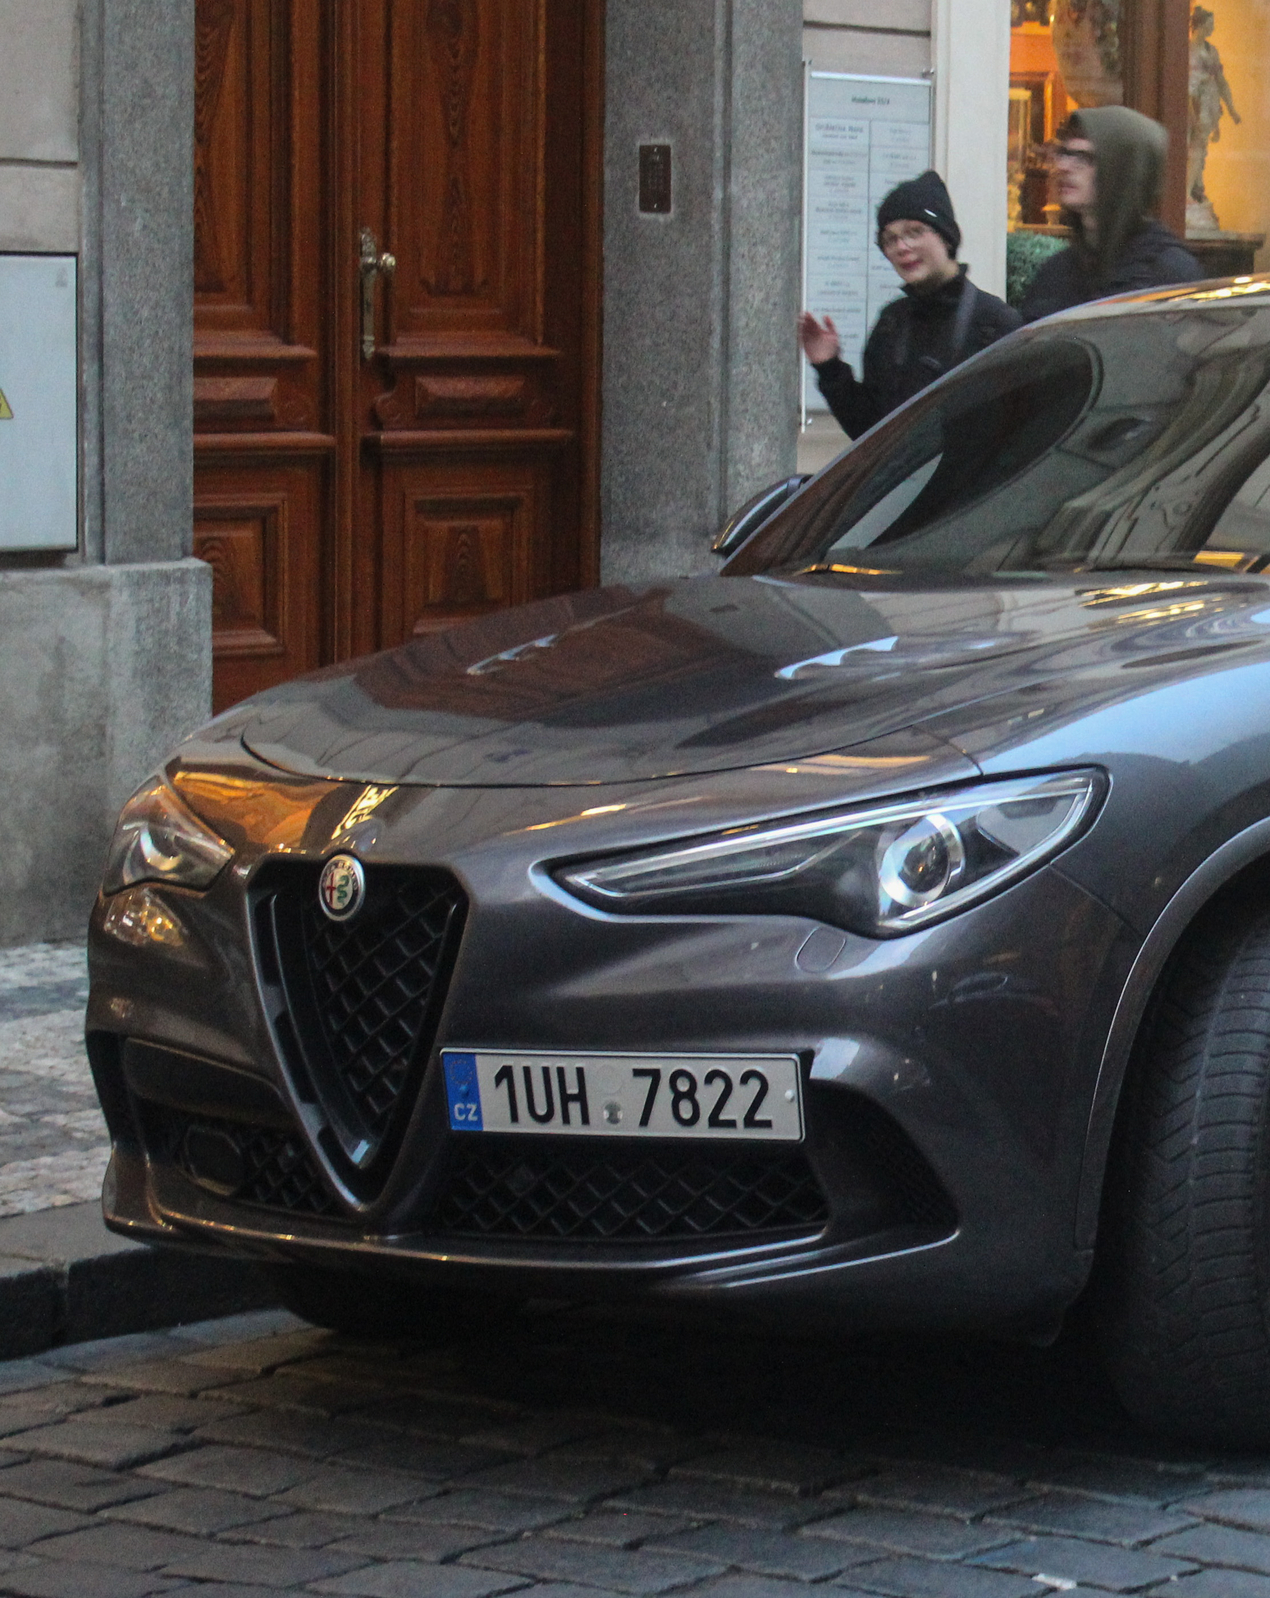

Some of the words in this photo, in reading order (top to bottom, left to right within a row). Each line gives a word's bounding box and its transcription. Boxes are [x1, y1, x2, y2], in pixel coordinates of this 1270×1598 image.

[453, 1103, 479, 1122] CZ
[494, 1065, 590, 1126] 1UH
[632, 1068, 773, 1130] 7822
